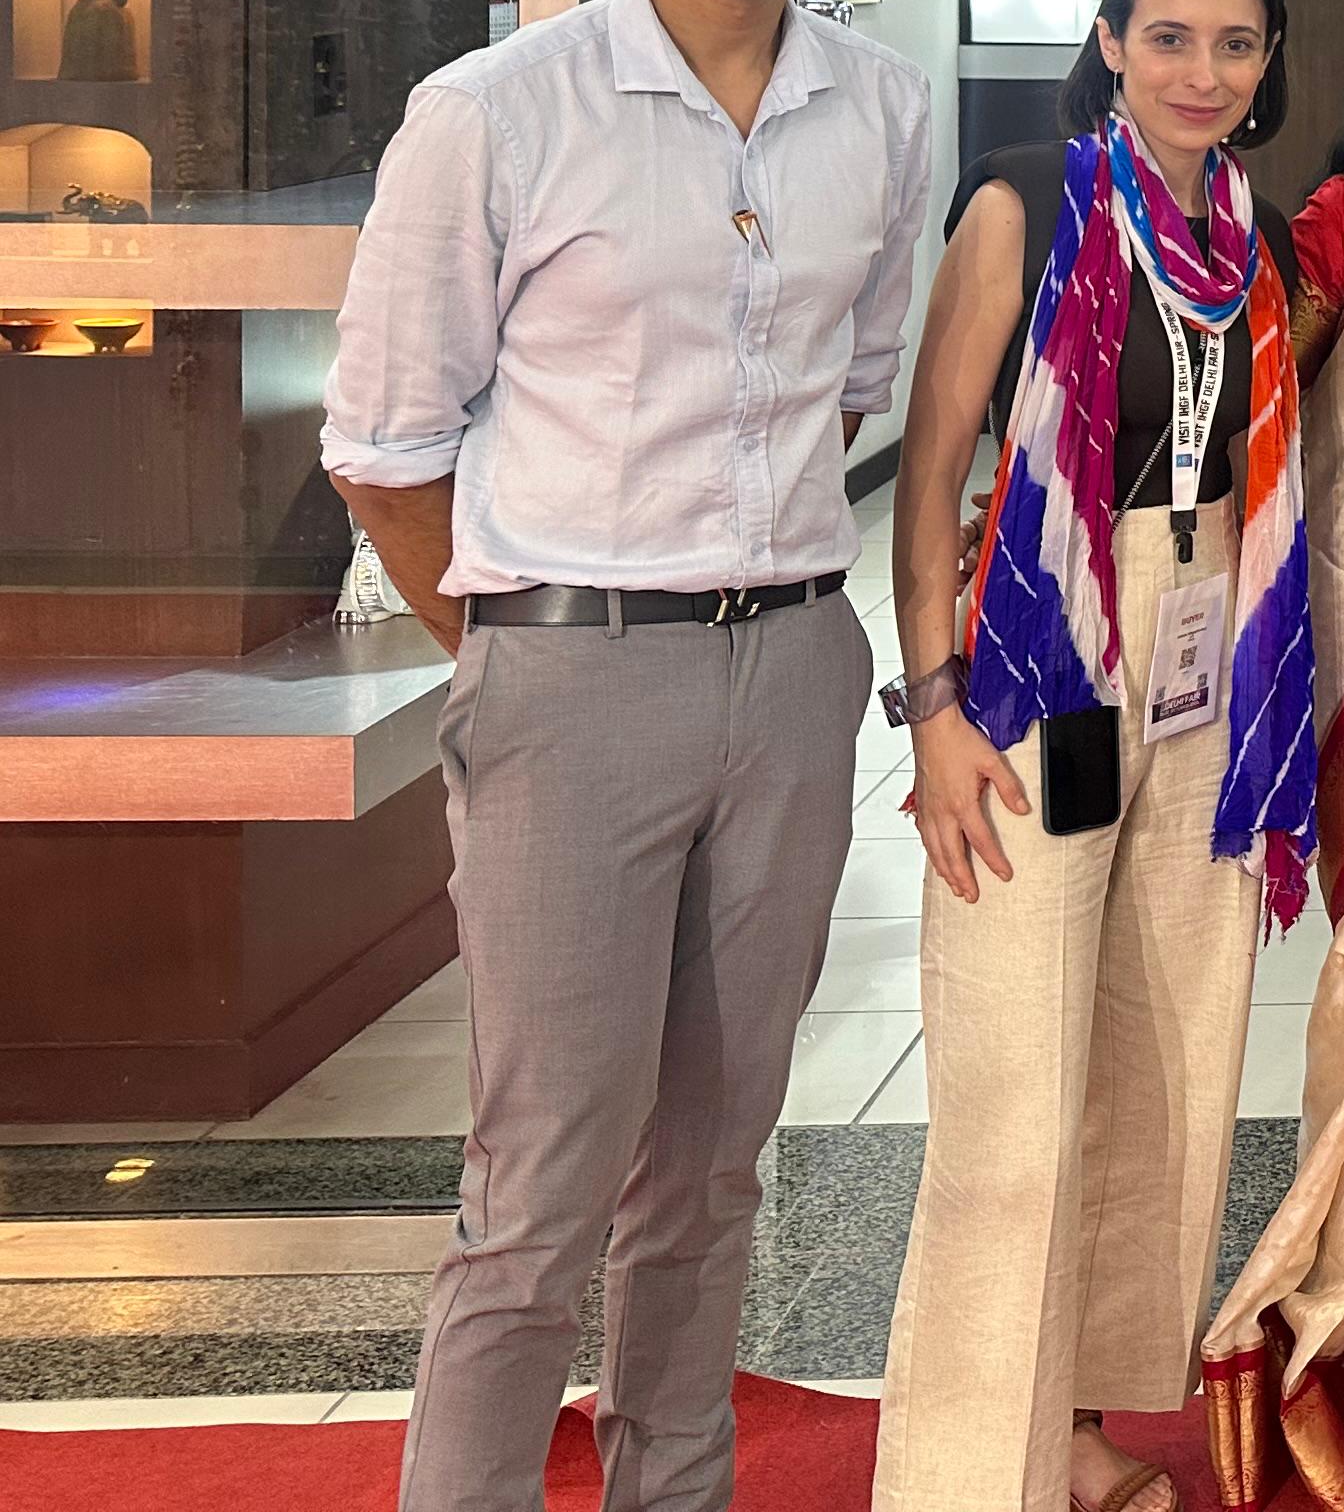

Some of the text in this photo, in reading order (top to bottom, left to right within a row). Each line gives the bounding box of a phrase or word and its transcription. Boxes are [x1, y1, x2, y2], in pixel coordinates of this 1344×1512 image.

[1178, 363, 1189, 392] DELHI
[1203, 368, 1217, 397] DELHI
[1178, 395, 1190, 417] IHGF
[1197, 399, 1212, 422] IHGF
[1178, 420, 1191, 446] VISIT
